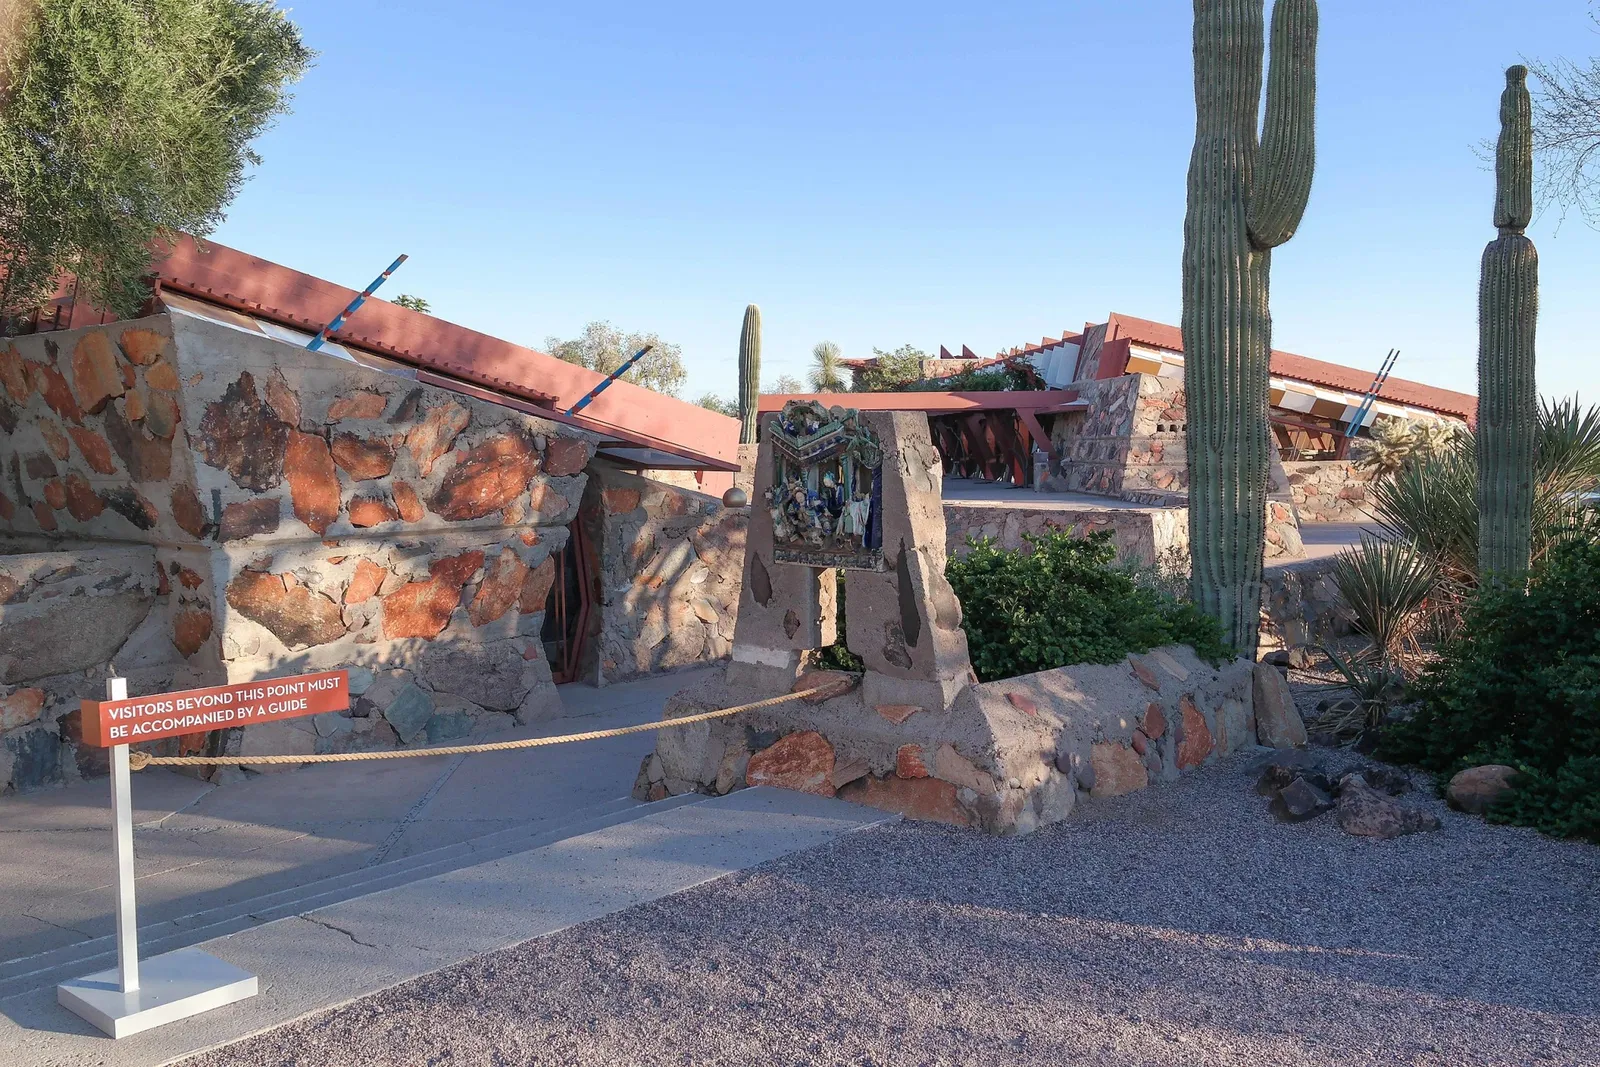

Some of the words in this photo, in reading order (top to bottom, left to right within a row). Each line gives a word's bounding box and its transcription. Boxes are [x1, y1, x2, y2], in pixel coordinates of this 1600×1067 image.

[108, 701, 174, 720] VISITORS
[177, 693, 233, 711] BEYOND
[236, 690, 264, 702] THIS
[268, 682, 305, 697] POINT
[308, 677, 341, 691] MUST
[110, 725, 128, 738] BE
[132, 710, 234, 735] ACCOMPANIED
[237, 706, 254, 718] BY
[257, 705, 266, 715] A
[268, 699, 307, 713] GUIDE
